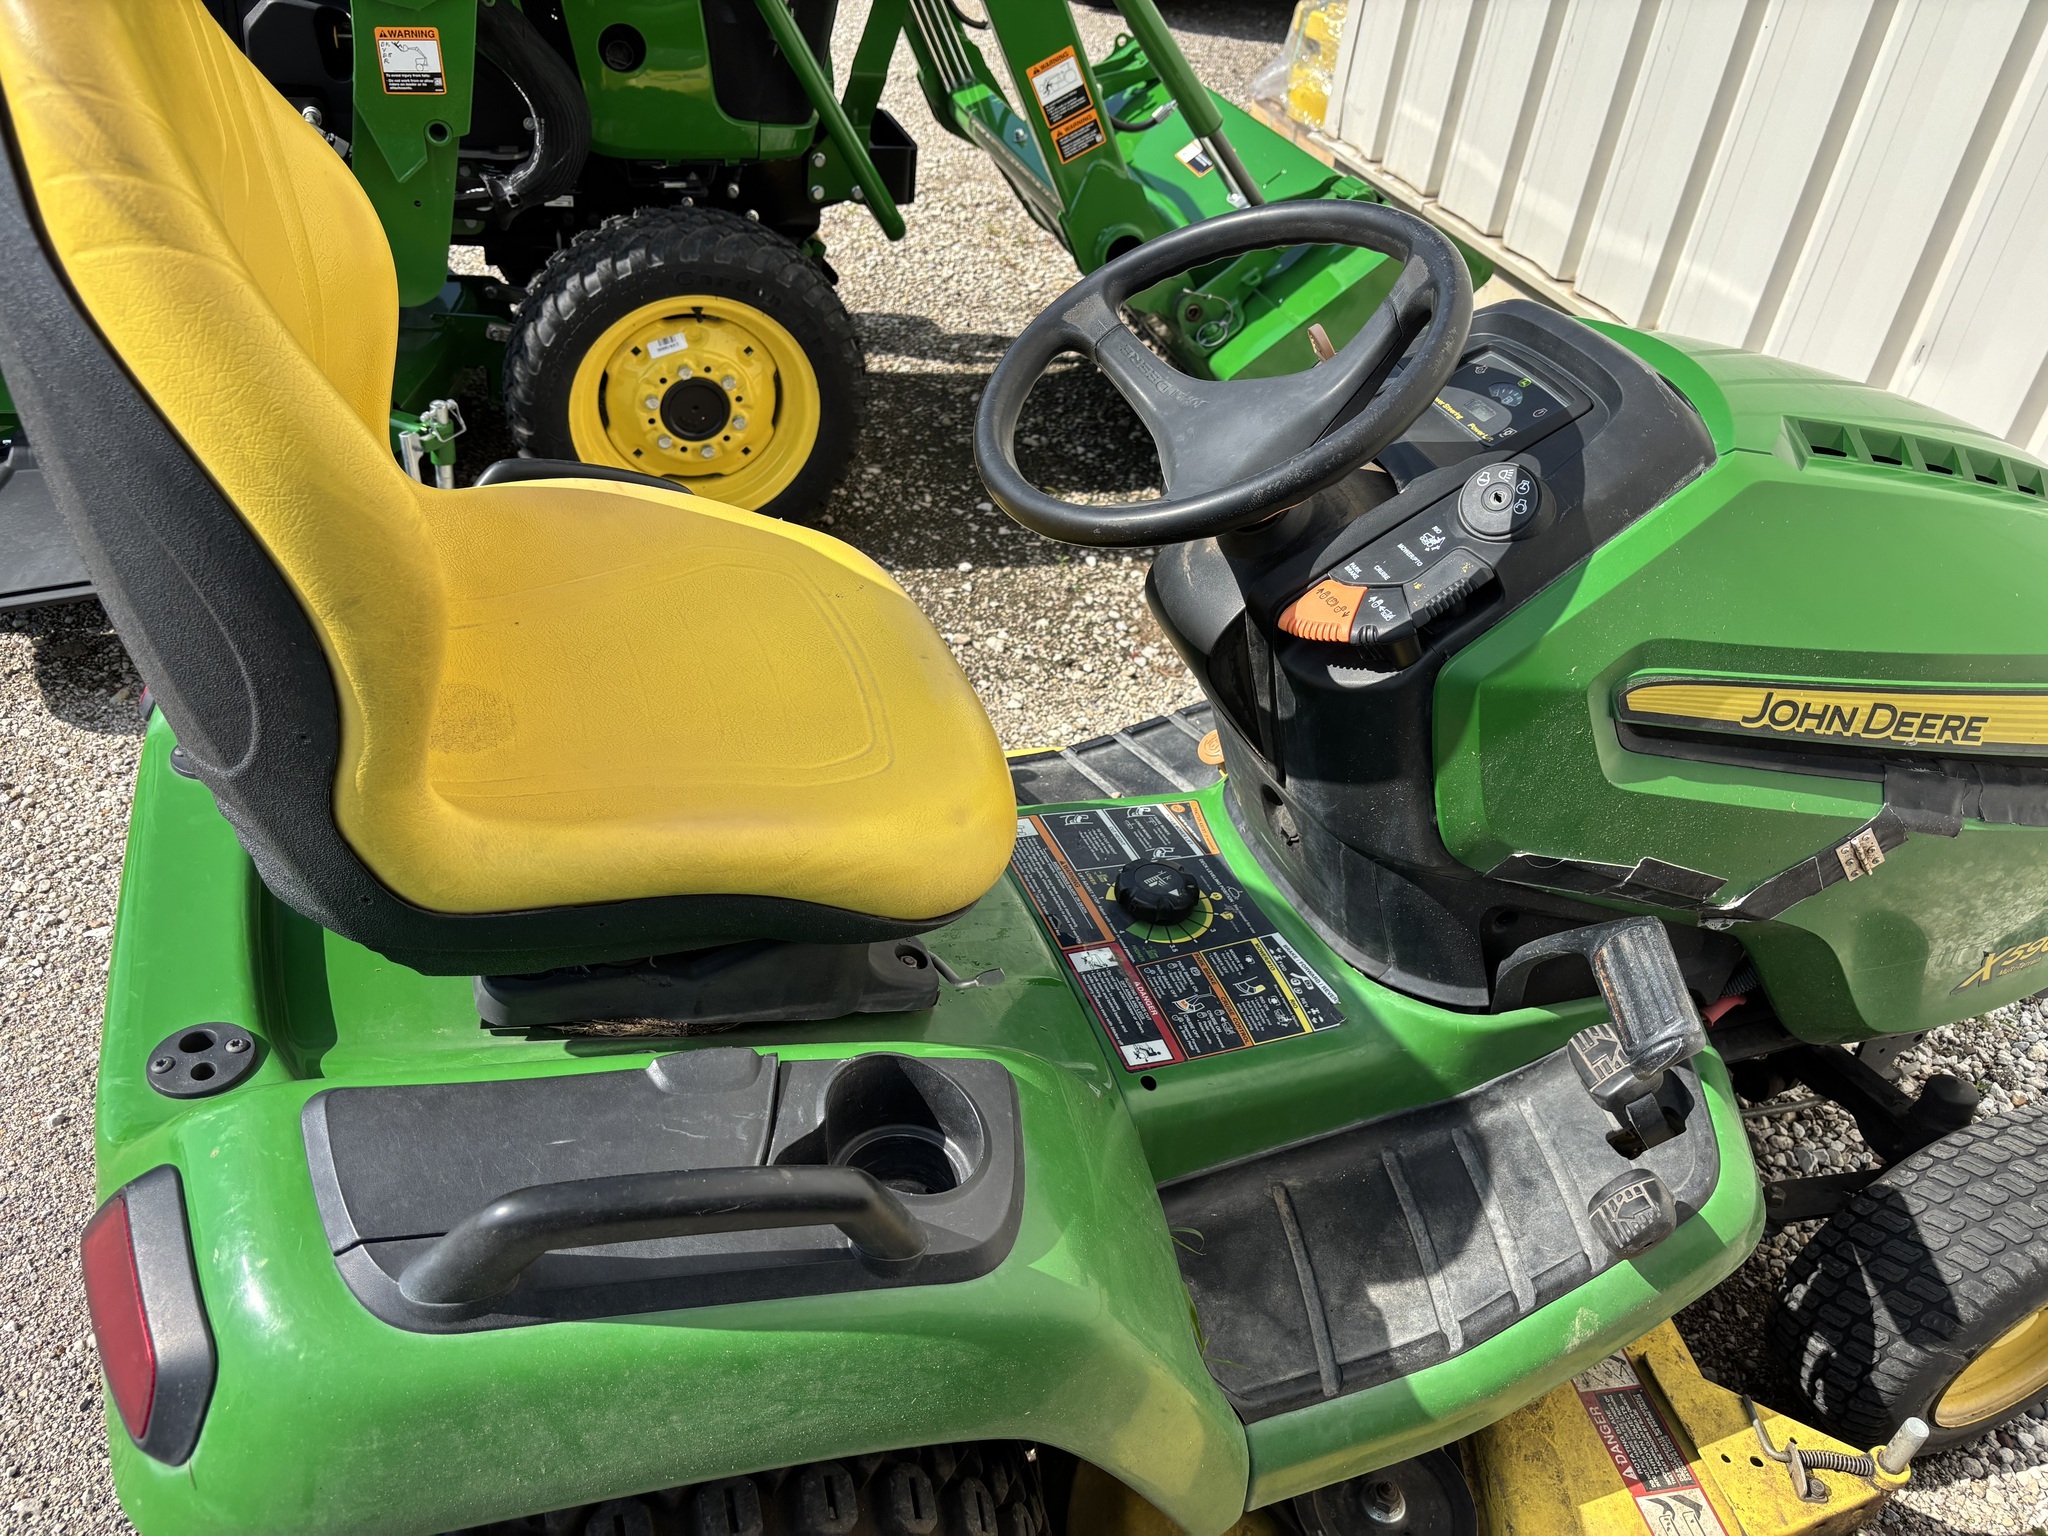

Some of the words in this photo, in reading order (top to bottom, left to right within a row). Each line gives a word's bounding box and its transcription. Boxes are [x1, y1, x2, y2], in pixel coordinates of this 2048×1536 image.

[387, 29, 435, 38] WARNING
[1039, 50, 1069, 70] WARNING
[1063, 113, 1092, 132] WARNING
[1121, 344, 1172, 394] DEERE
[1431, 524, 1442, 535] RIO
[1396, 541, 1423, 568] MOWER/PTO
[1343, 564, 1359, 580] BRAKE
[1349, 561, 1362, 574] PARK
[1373, 563, 1390, 581] CRUISE
[1741, 692, 1859, 733] JOHN
[1861, 703, 1989, 742] DEERE
[1062, 865, 1081, 887] WARNING
[1197, 858, 1209, 867] DECK
[1205, 868, 1222, 885] LEVELING
[1219, 885, 1234, 902] POSITION
[1168, 944, 1178, 952] 3.5
[1228, 949, 1240, 963] MOWER
[1253, 943, 1275, 971] MOWER/PTO
[1176, 960, 1185, 970] PARK
[1182, 971, 1194, 985] BRAKE
[1193, 953, 1205, 966] PARK
[1202, 968, 1217, 985] BRAKE
[1212, 952, 1223, 965] MOWER
[1221, 965, 1229, 973] OFF
[1276, 960, 1288, 971] FWD
[1281, 944, 1299, 958] BRAKE
[1297, 961, 1321, 983] FORWARD
[1154, 964, 1164, 975] PARK
[1161, 975, 1172, 988] BRAKE
[1169, 989, 1177, 997] OFF
[1136, 986, 1158, 1015] DANGER
[1288, 998, 1298, 1008] RIO
[1298, 997, 1310, 1008] REV
[1182, 1013, 1195, 1029] CRUISE
[1191, 1029, 1200, 1038] OFF
[1205, 1009, 1218, 1024] CRUISE
[1219, 996, 1234, 1015] CRUISE
[1230, 1017, 1251, 1043] CONTROL
[1604, 1409, 1622, 1434] BLADE
[1618, 1405, 1642, 1439] OBJECTS
[1588, 1406, 1628, 1464] DANGER
[1618, 1435, 1643, 1474] ROTATING
[1637, 1440, 1661, 1474] THROWN
